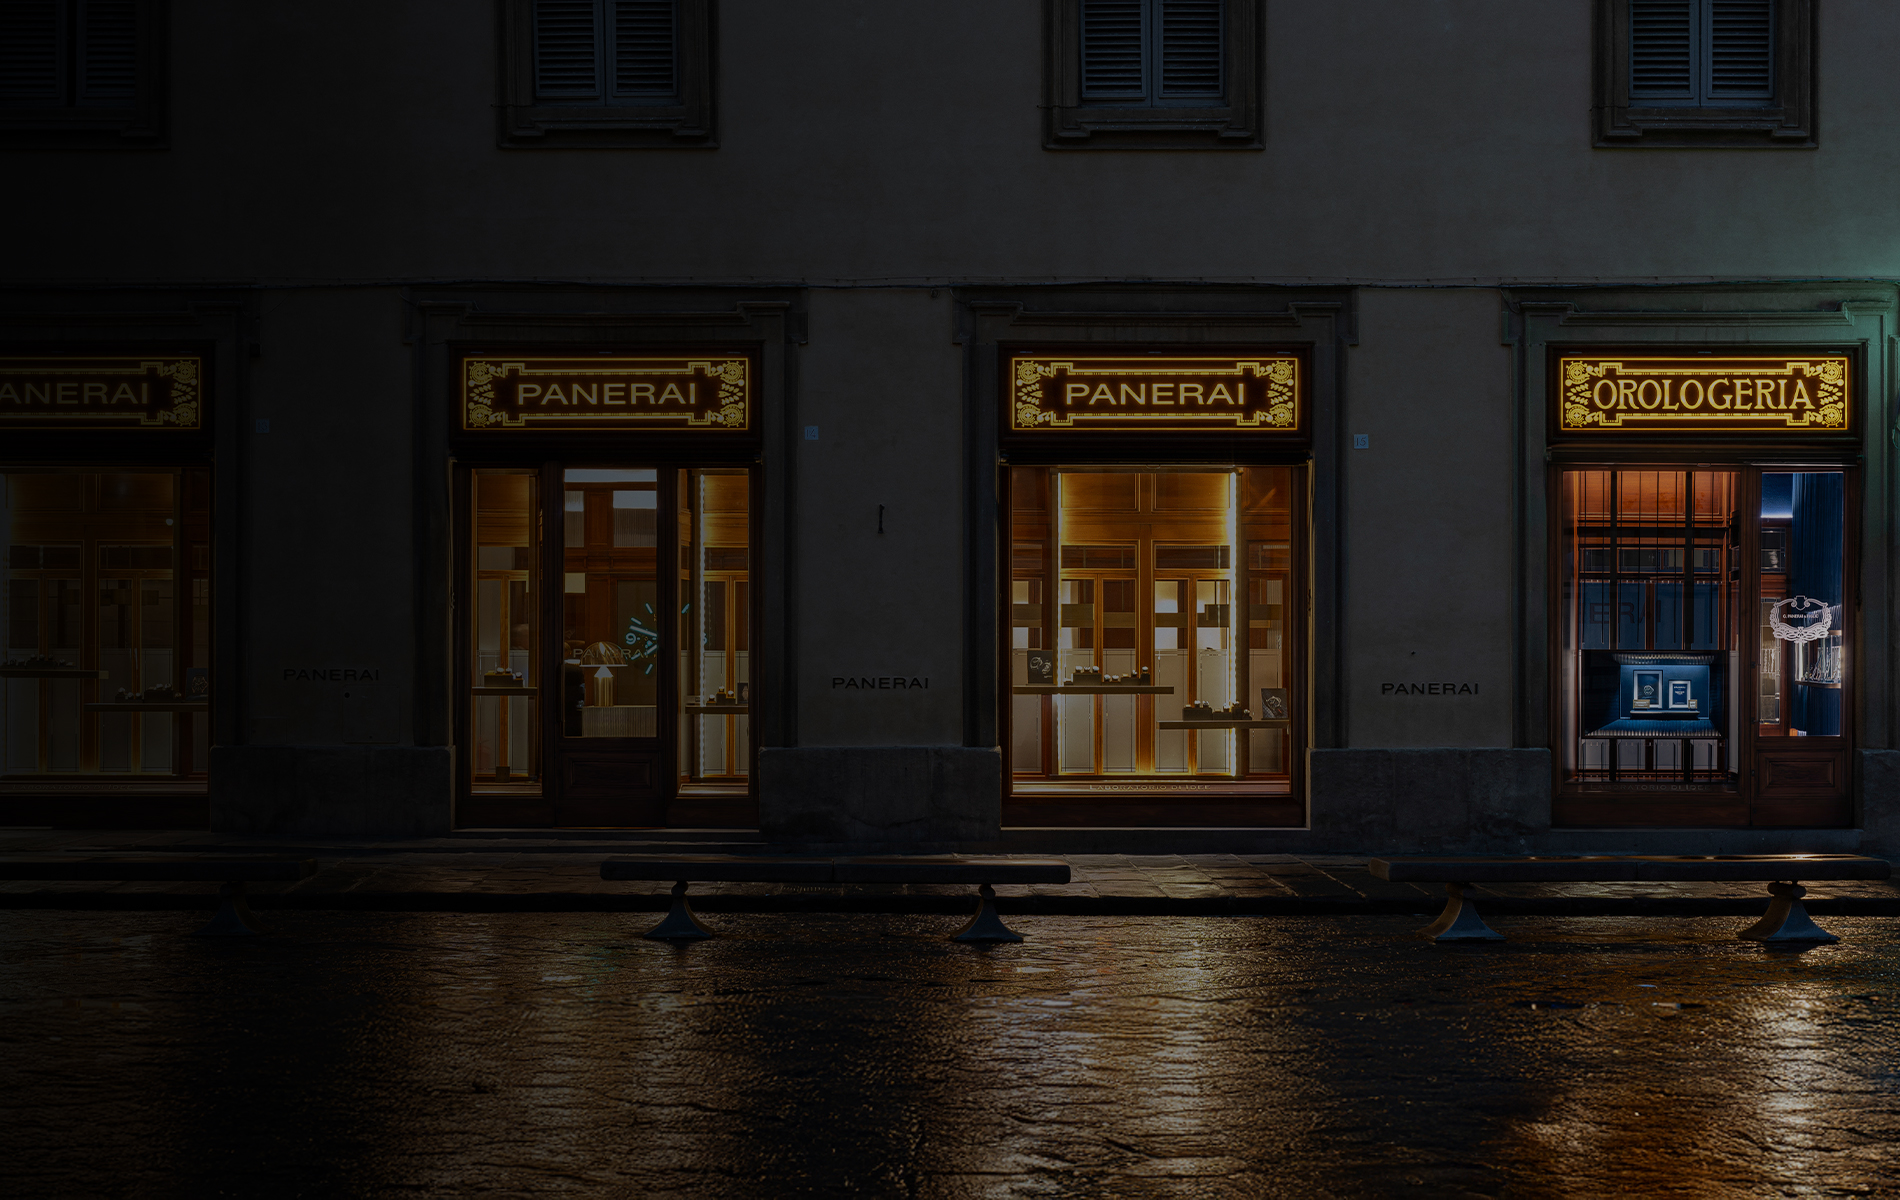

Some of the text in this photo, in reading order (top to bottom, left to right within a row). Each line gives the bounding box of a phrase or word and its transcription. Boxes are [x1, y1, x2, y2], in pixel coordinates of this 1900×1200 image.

[0, 382, 149, 405] ANERAI
[517, 383, 696, 405] PANERAI
[1065, 383, 1245, 405] PANERAI
[1593, 377, 1816, 411] OROLOGERIA
[1356, 436, 1367, 447] 15
[283, 669, 379, 681] PANERAI
[832, 677, 928, 689] PANERAI
[1381, 683, 1478, 695] PANERAI
